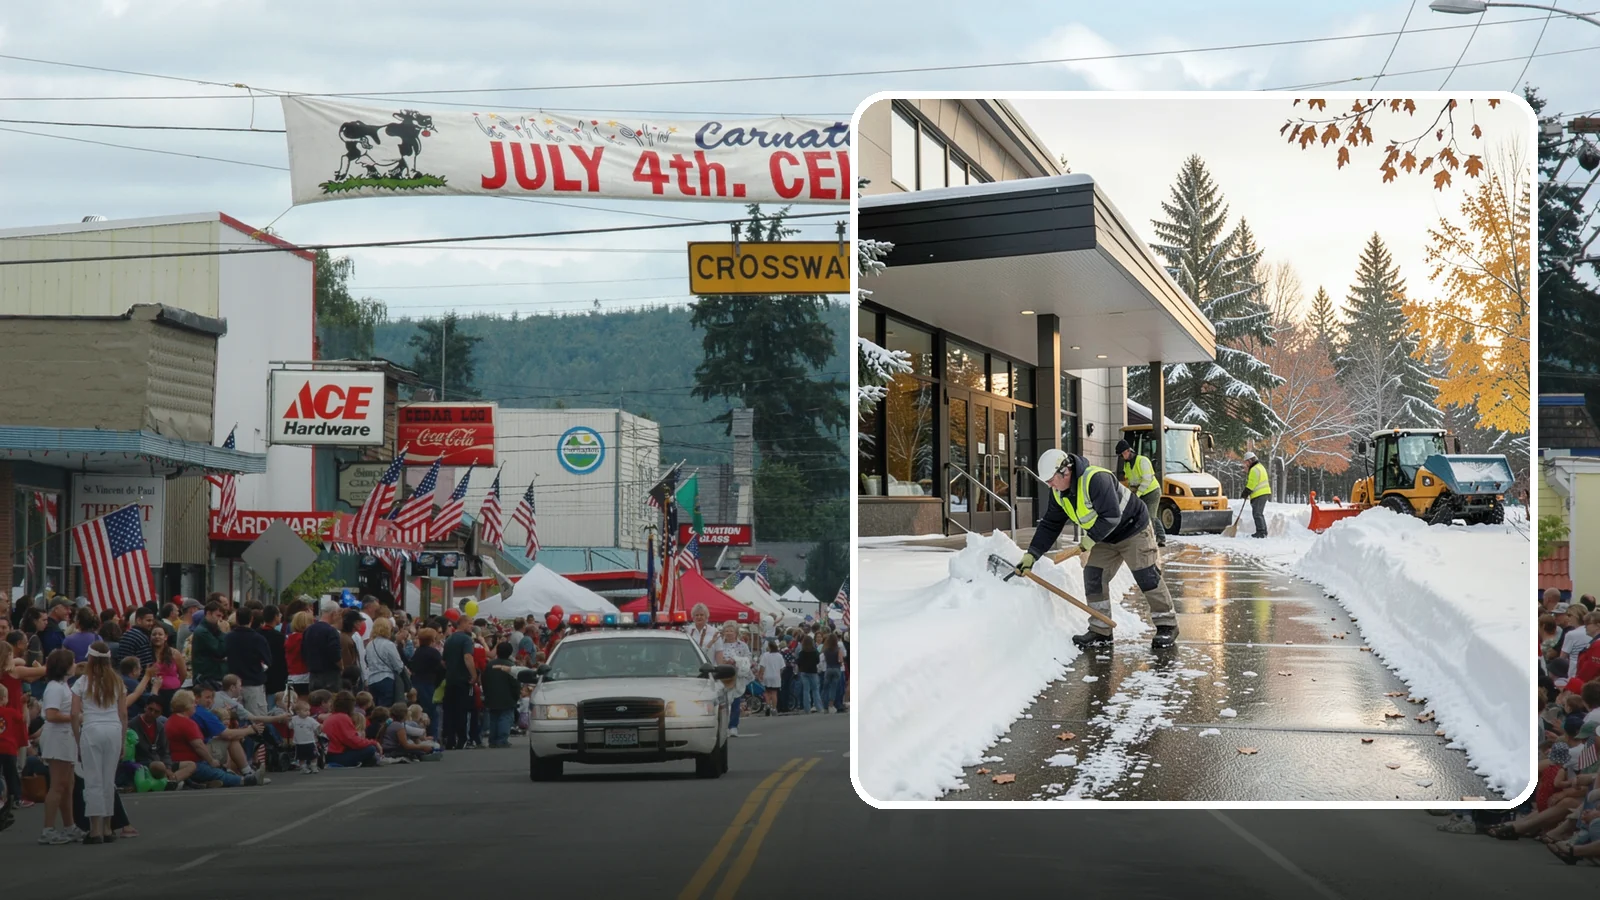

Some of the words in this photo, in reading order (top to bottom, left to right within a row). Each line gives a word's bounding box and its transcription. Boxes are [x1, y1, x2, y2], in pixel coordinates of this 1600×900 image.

[694, 121, 850, 150] Carnat
[481, 141, 605, 193] JULY
[632, 150, 747, 198] 4th.
[282, 380, 374, 420] ACE
[405, 409, 453, 421] CEDAR
[283, 421, 371, 437] Hardware
[416, 428, 478, 447] Coca-Cola
[353, 467, 386, 482] Simpl
[96, 485, 124, 495] Vincent
[126, 485, 136, 495] de
[137, 486, 155, 496] Paul
[81, 503, 154, 522] THT
[688, 526, 742, 536] CRNATION
[699, 535, 731, 544] GLASS
